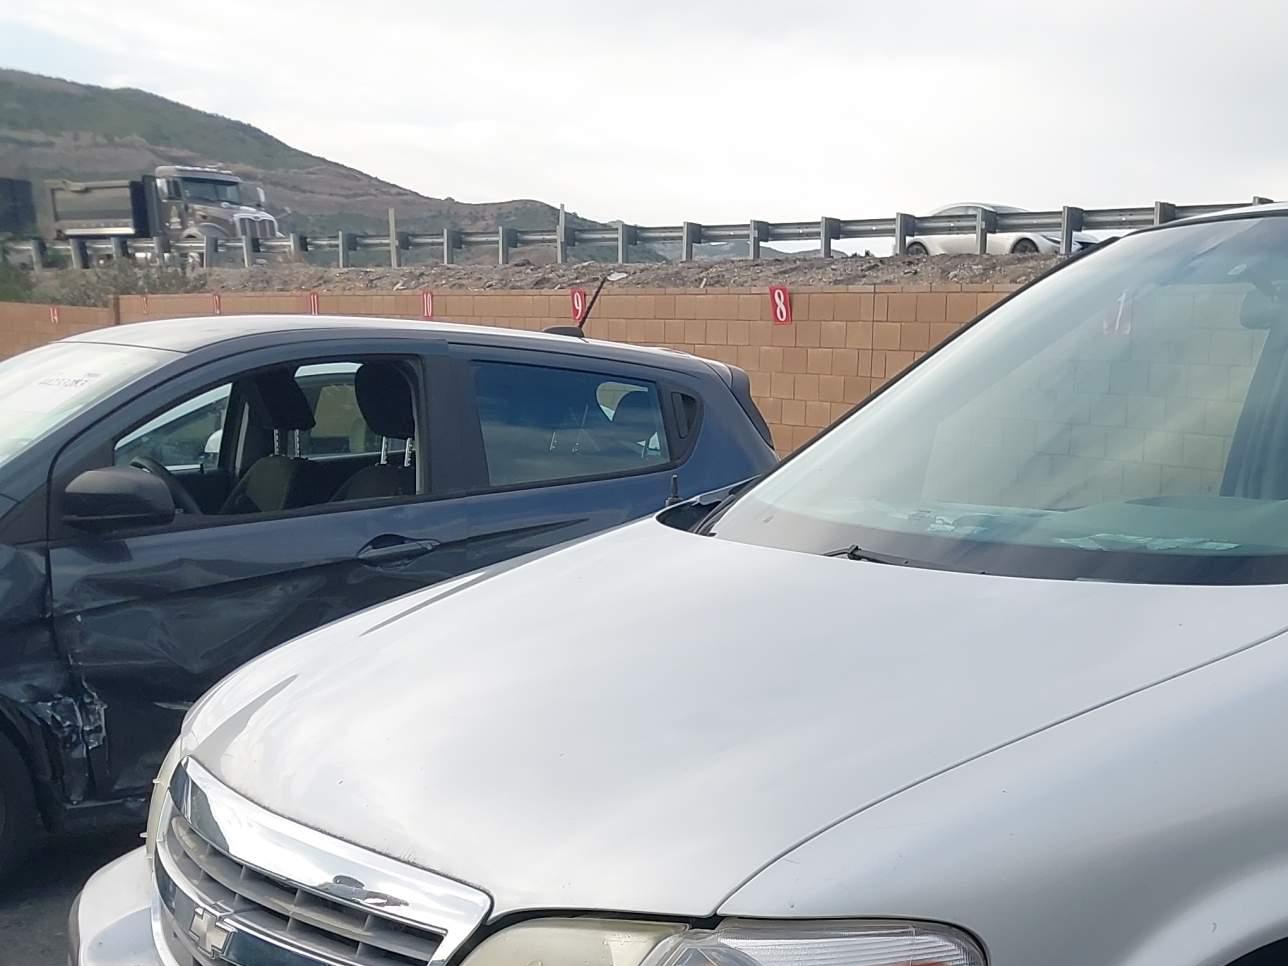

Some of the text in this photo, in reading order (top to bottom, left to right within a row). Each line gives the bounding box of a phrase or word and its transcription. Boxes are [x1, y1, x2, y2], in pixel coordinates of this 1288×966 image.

[422, 293, 432, 317] 10
[573, 291, 582, 320] 9
[774, 289, 787, 322] 8
